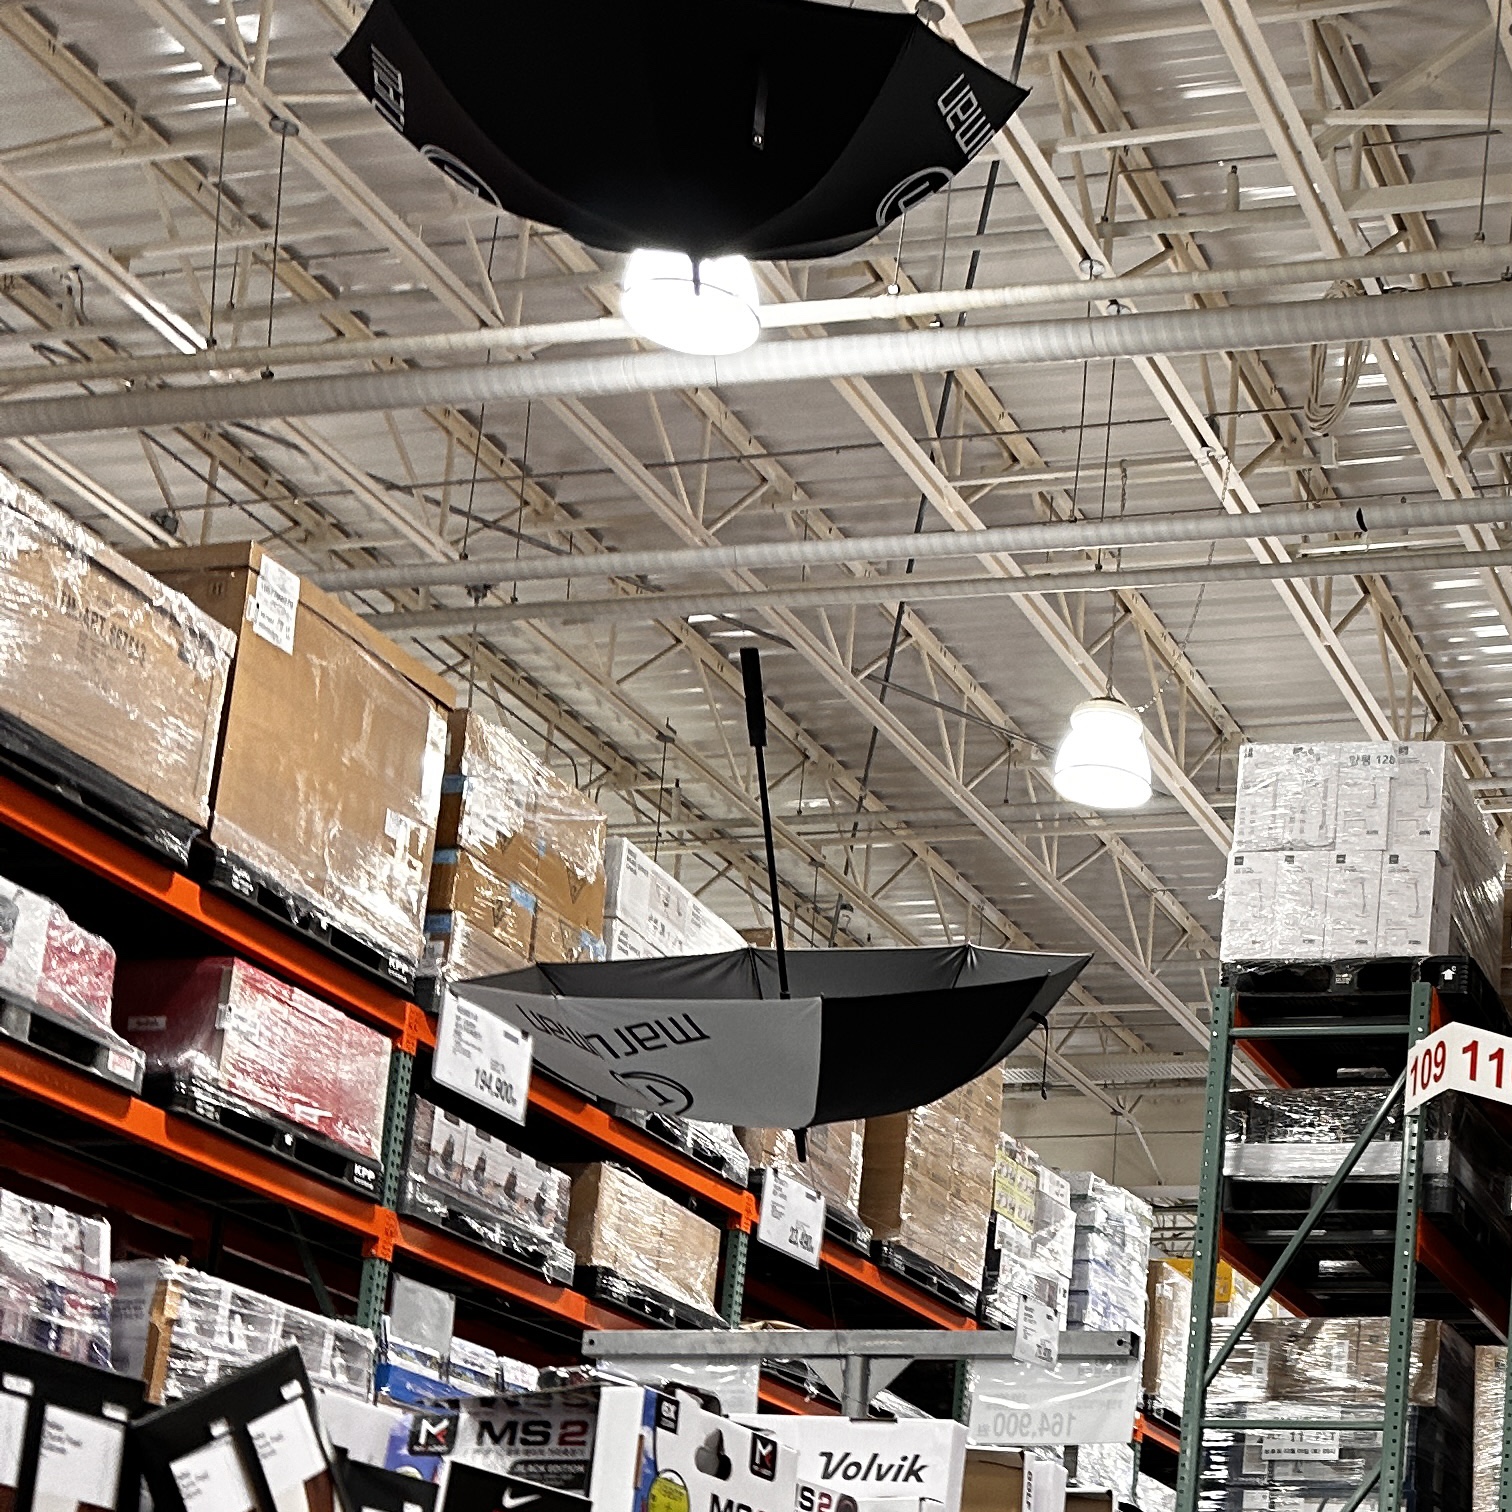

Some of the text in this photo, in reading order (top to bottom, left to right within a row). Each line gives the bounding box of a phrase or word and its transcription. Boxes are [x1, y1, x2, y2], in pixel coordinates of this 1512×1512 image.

[1410, 1040, 1446, 1096] 109
[476, 1420, 589, 1447] MS2
[819, 1451, 928, 1483] Volvik
